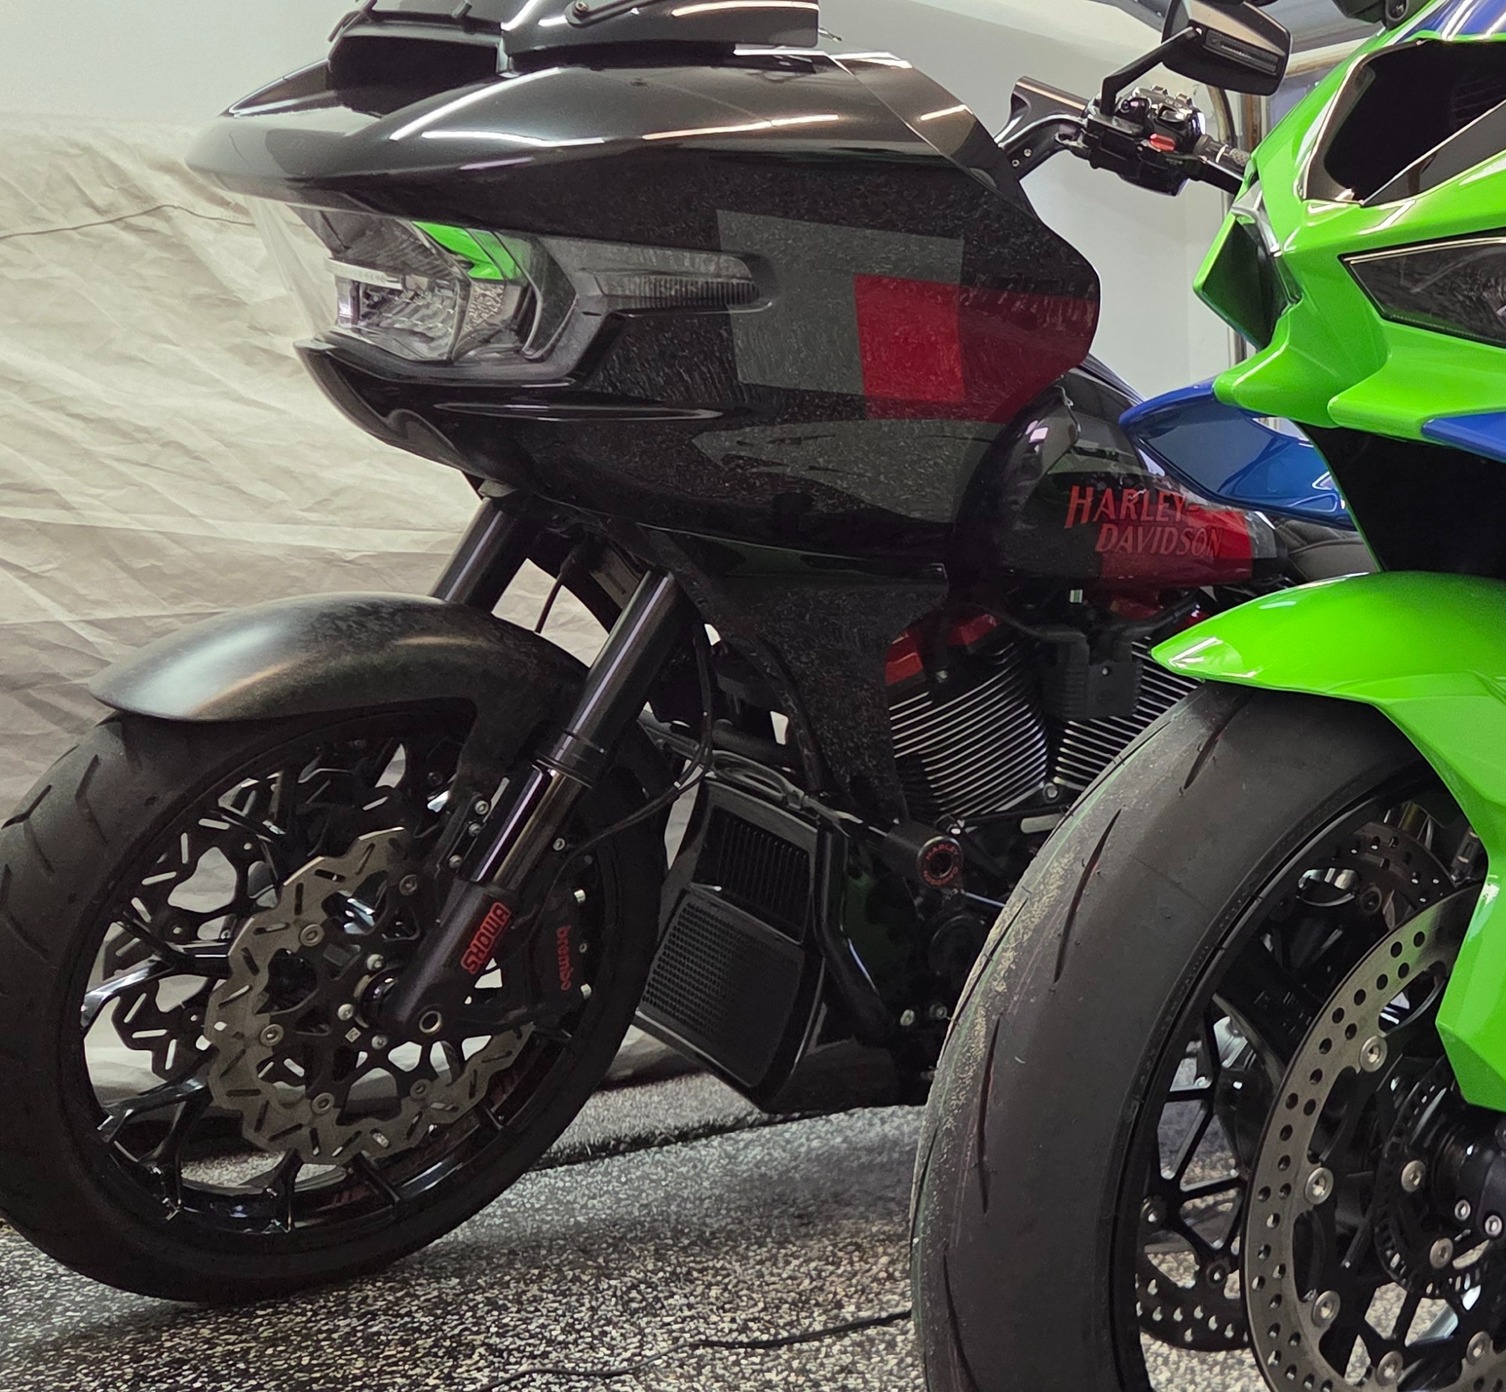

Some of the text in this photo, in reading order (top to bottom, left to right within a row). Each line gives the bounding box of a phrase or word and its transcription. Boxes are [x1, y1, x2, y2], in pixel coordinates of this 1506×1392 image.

[1095, 523, 1221, 570] DAVIDSON
[461, 902, 511, 974] SHOWA
[556, 925, 574, 991] brembo
